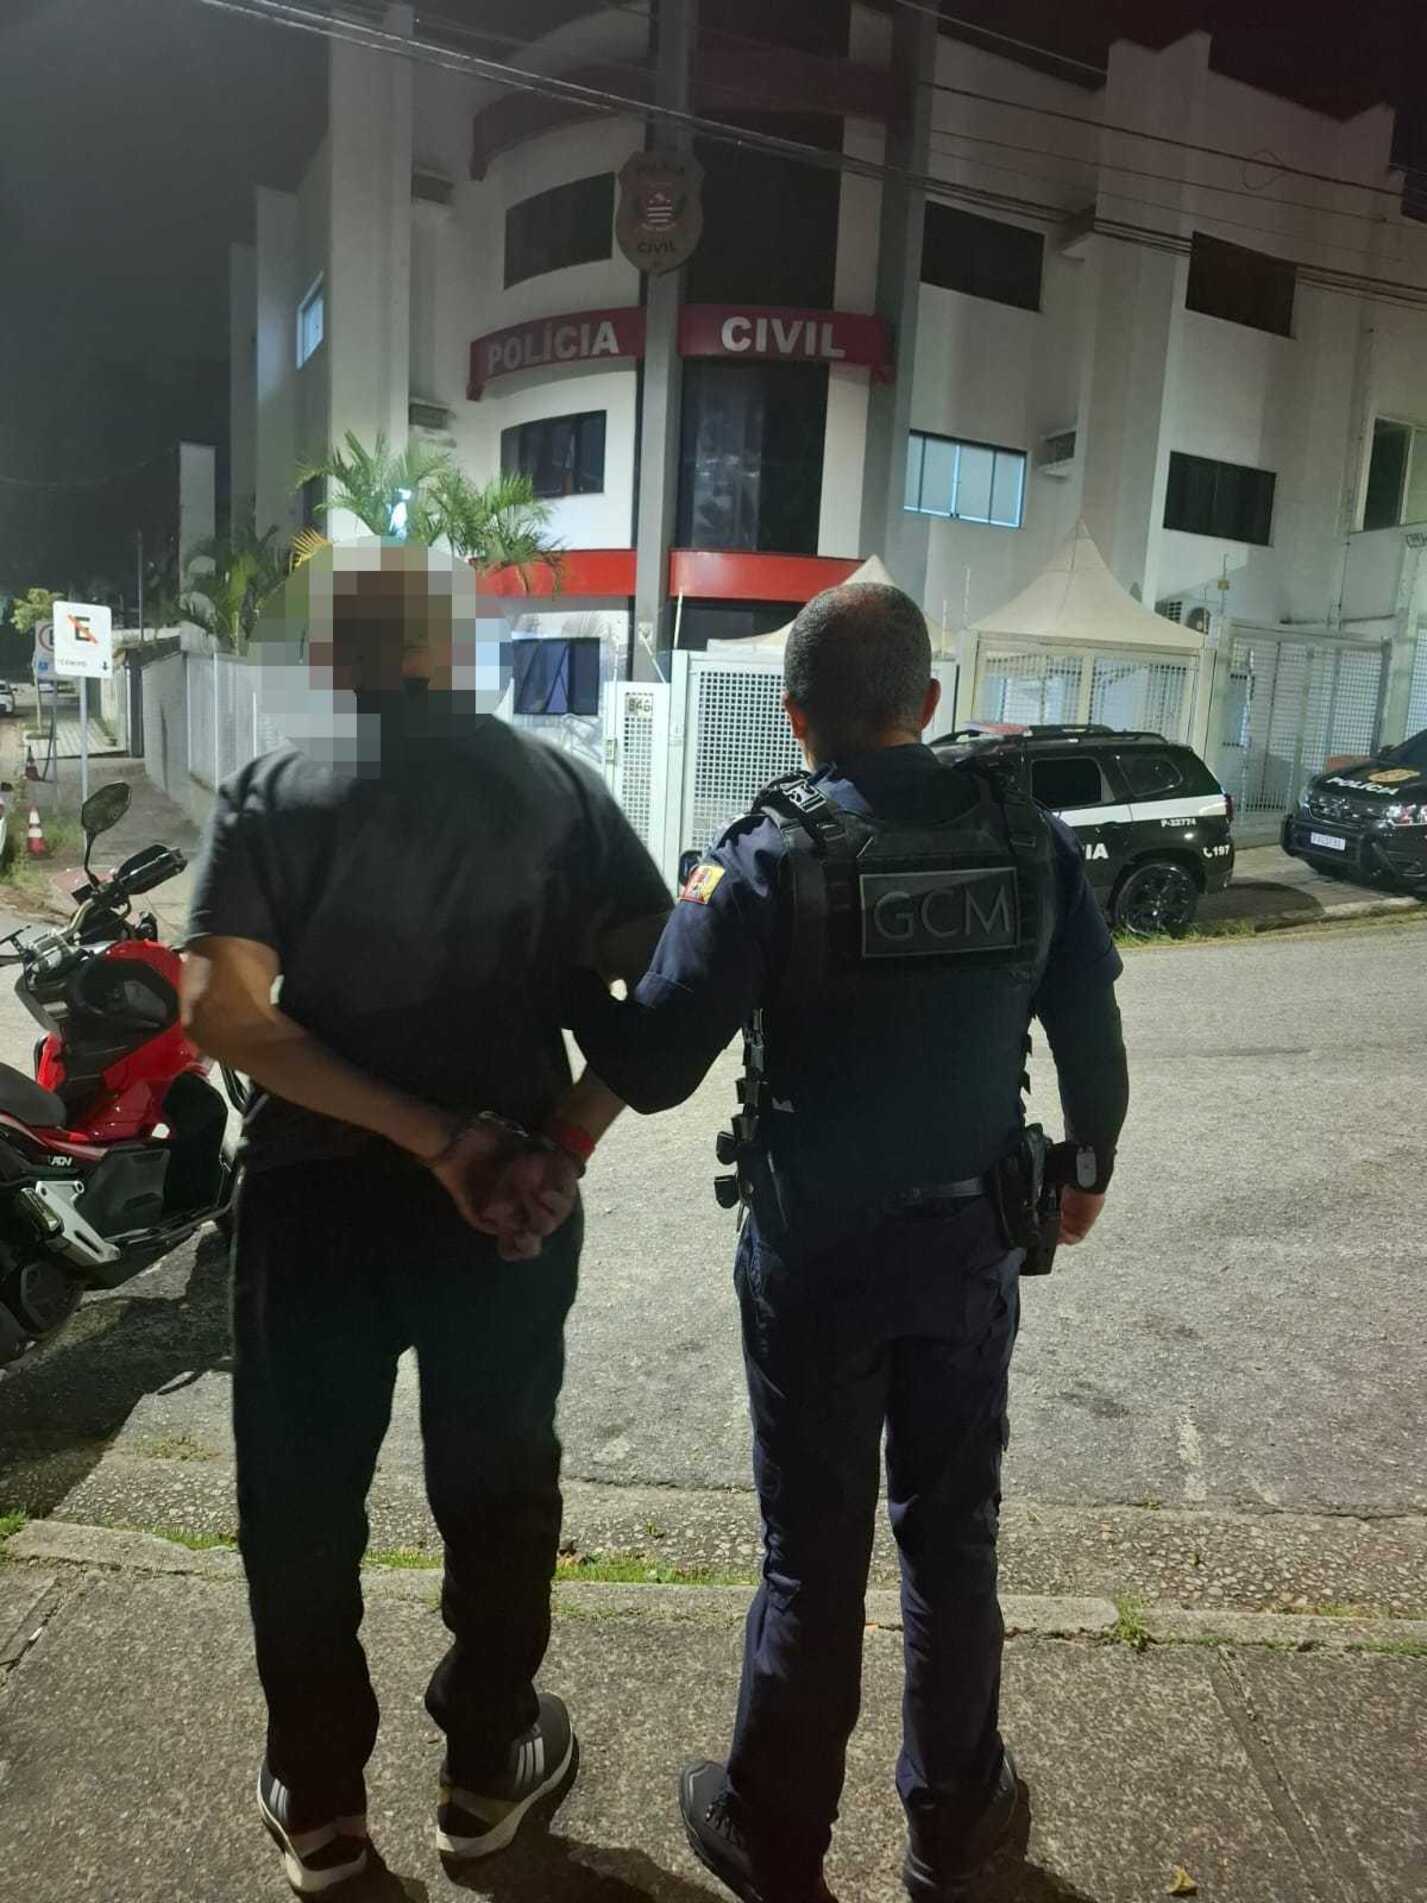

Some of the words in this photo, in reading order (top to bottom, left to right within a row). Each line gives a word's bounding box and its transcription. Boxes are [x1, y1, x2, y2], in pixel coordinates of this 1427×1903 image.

[638, 240, 677, 254] CIVIL
[487, 320, 620, 374] POLÍCIA
[720, 315, 846, 358] CIVIL
[874, 885, 1011, 940] GCM
